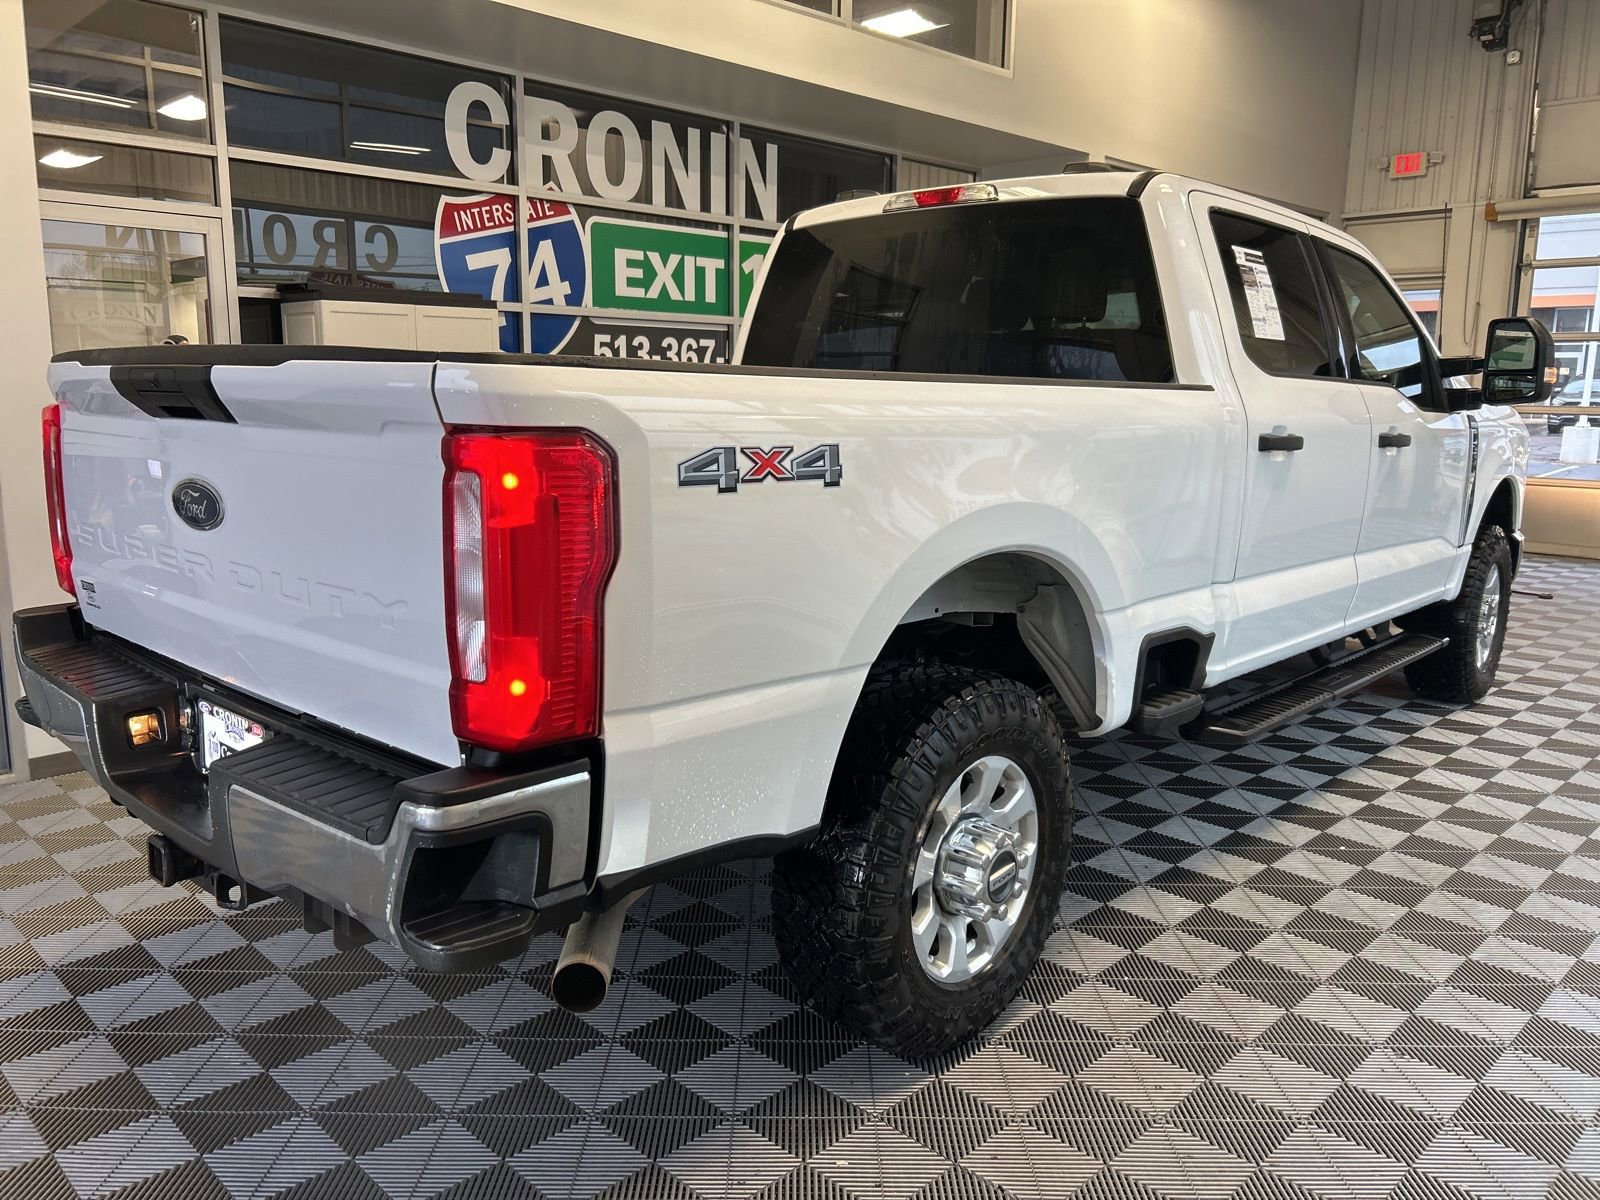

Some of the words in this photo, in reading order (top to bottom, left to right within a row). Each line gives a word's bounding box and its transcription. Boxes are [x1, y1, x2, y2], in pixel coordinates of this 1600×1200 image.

[443, 81, 779, 223] CRONIN
[1394, 153, 1424, 176] EXIT
[453, 199, 555, 233] INTERSATE
[465, 238, 572, 327] 74
[614, 247, 726, 304] EXIT
[180, 488, 208, 520] Ford
[75, 522, 216, 583] SUPER
[229, 560, 409, 631] DUTY
[213, 706, 249, 731] CRONIN
